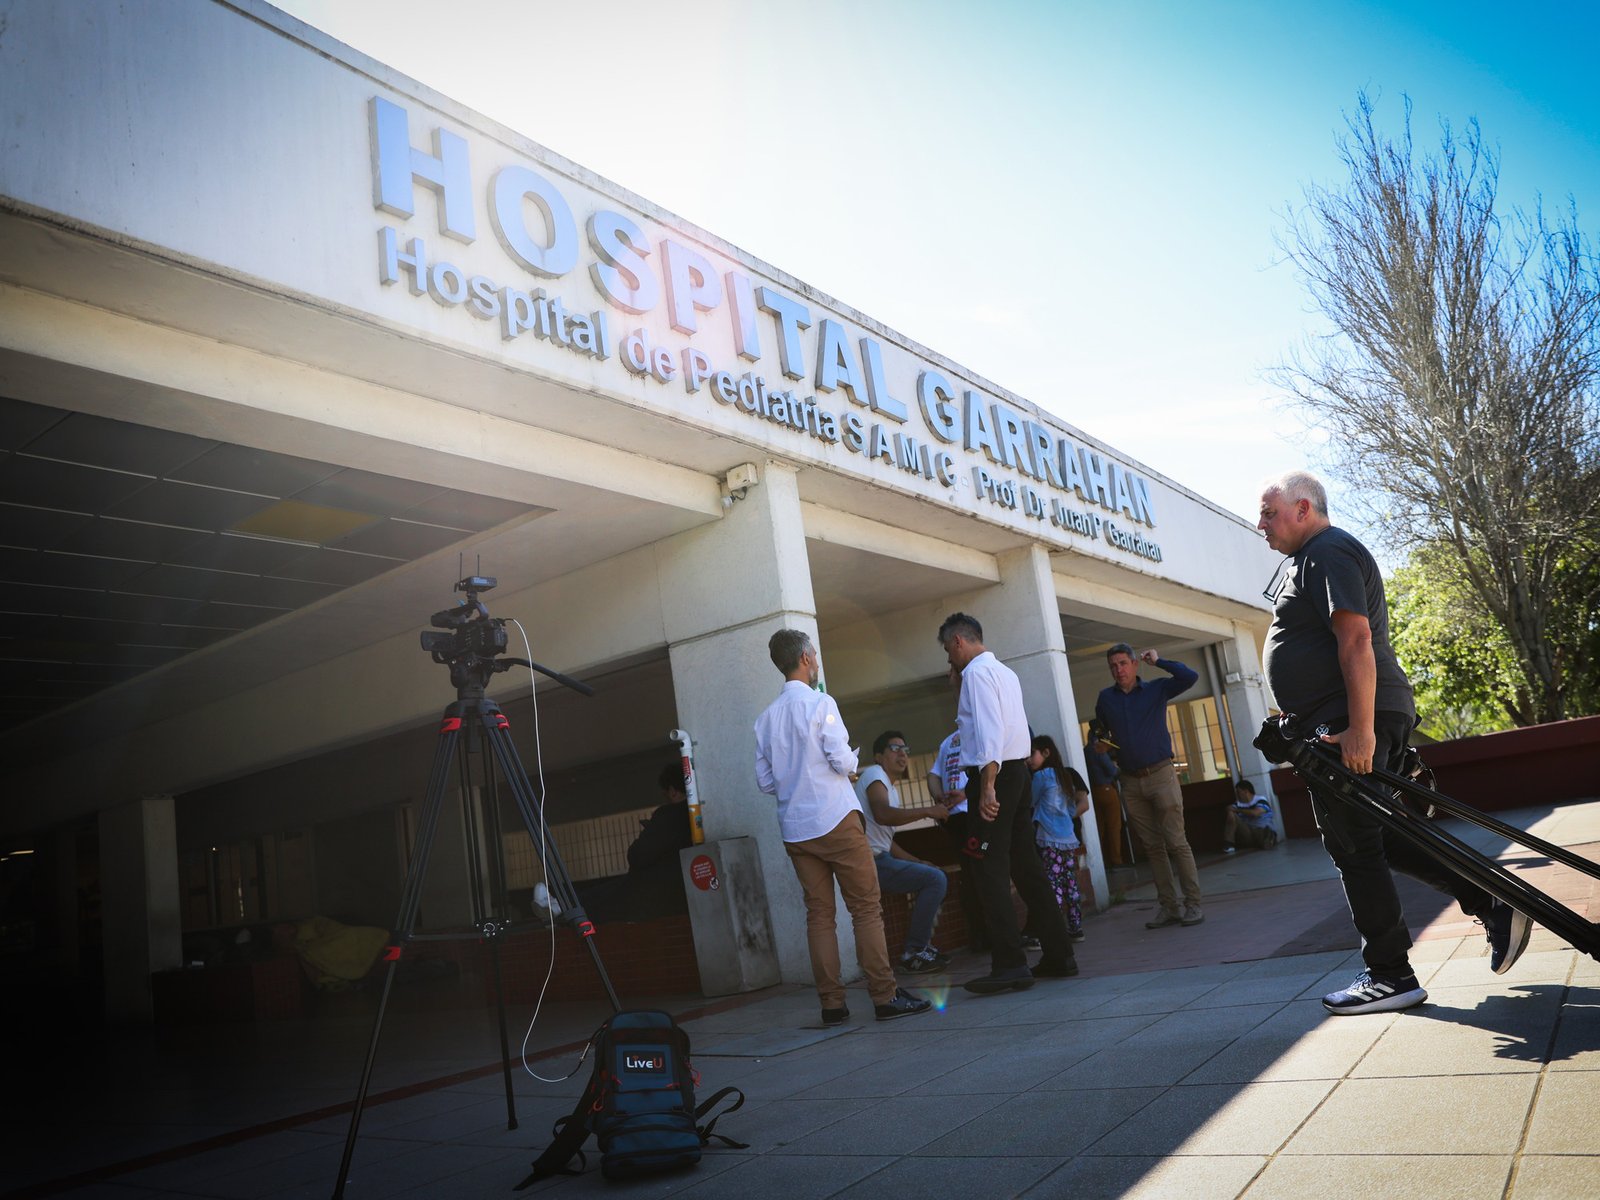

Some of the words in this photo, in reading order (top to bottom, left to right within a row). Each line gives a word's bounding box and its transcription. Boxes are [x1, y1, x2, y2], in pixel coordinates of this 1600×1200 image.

[367, 96, 908, 424] HOSPITAL
[917, 371, 1157, 528] GARRAHAN
[377, 226, 611, 361] Hospital
[619, 328, 677, 385] de
[681, 347, 840, 445] Pediatria
[1051, 499, 1092, 537] Juan
[1103, 519, 1163, 563] Garrahan
[626, 1055, 663, 1069] LiveU
